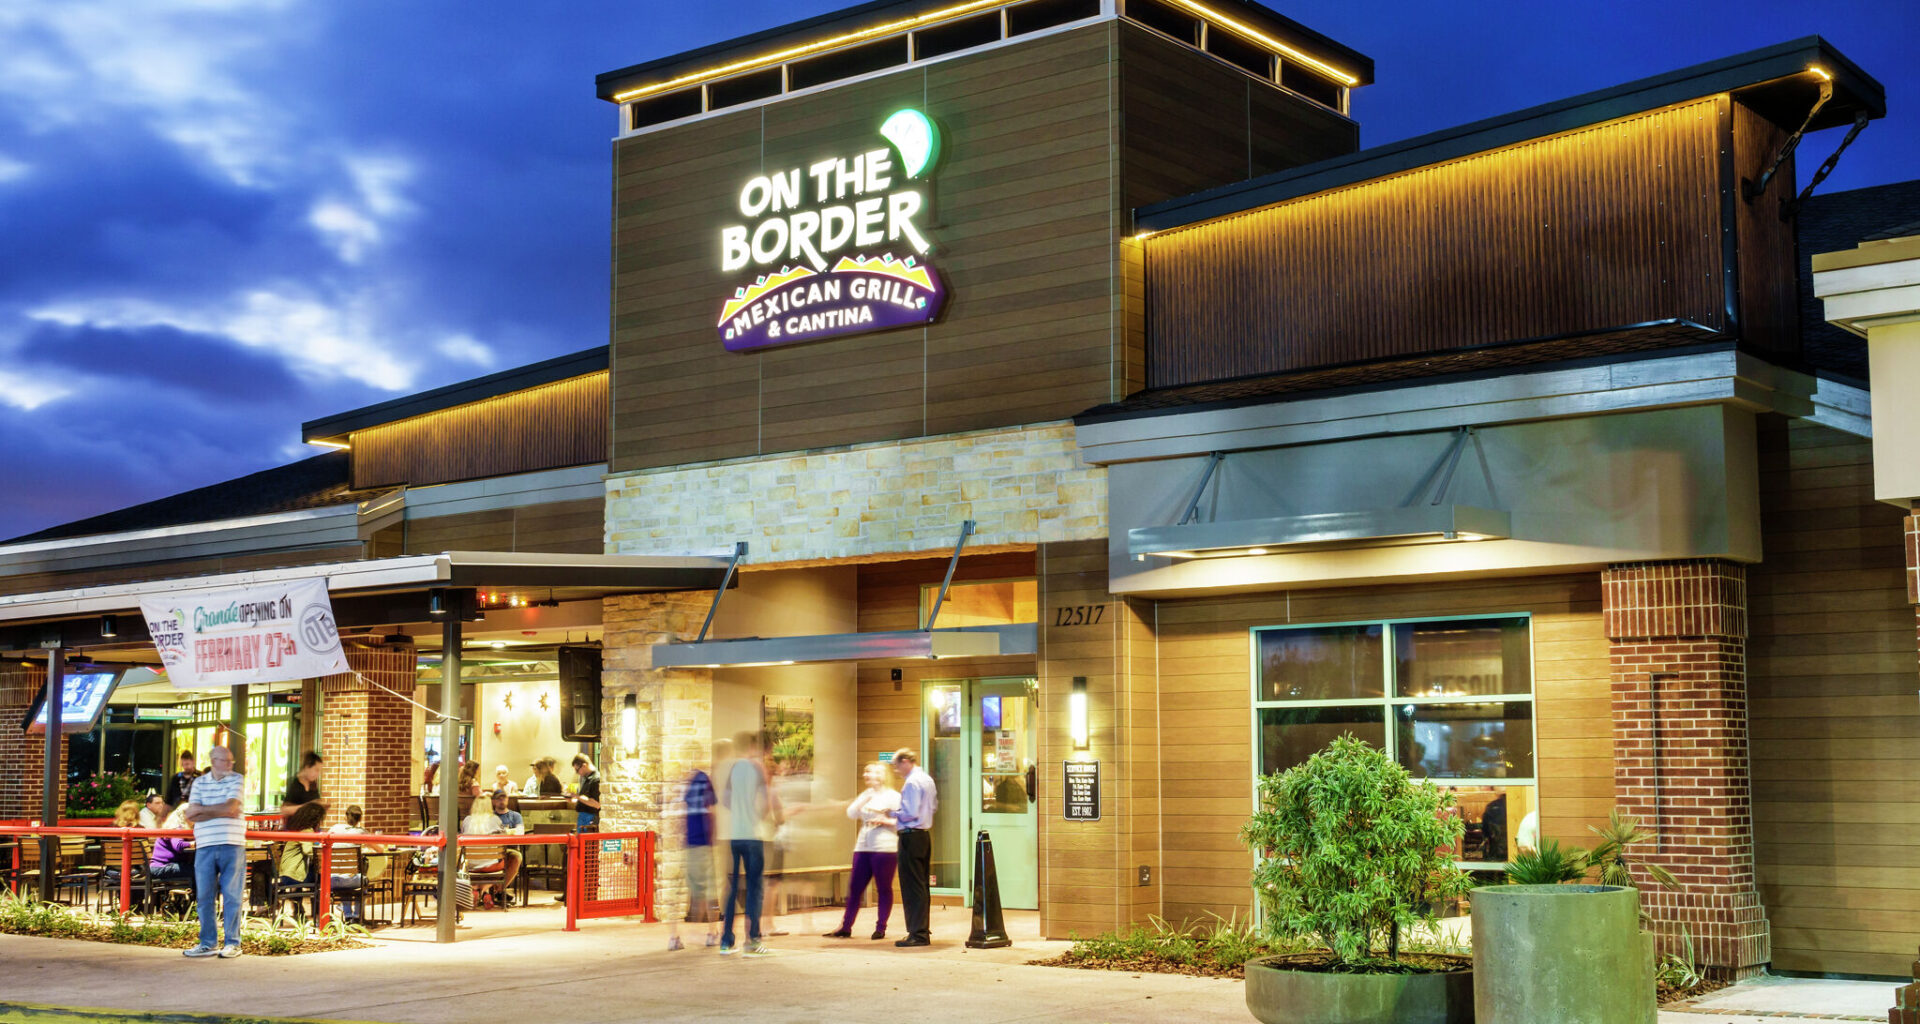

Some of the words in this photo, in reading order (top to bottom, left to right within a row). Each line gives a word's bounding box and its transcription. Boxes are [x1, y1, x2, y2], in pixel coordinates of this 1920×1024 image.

[739, 168, 802, 217] ON
[810, 148, 892, 206] THE
[721, 190, 931, 273] BORDER
[732, 278, 841, 336] MEXICAN
[849, 277, 918, 310] GRILL
[767, 320, 782, 338] &
[785, 304, 873, 335] CANTINA
[149, 621, 161, 633] ON
[162, 619, 179, 631] THE
[193, 600, 239, 634] Grande
[238, 600, 276, 624] OPENING
[279, 597, 293, 619] ON
[1054, 604, 1105, 628] 12517
[194, 634, 262, 674] FEBRUARY
[264, 631, 298, 668] 27th
